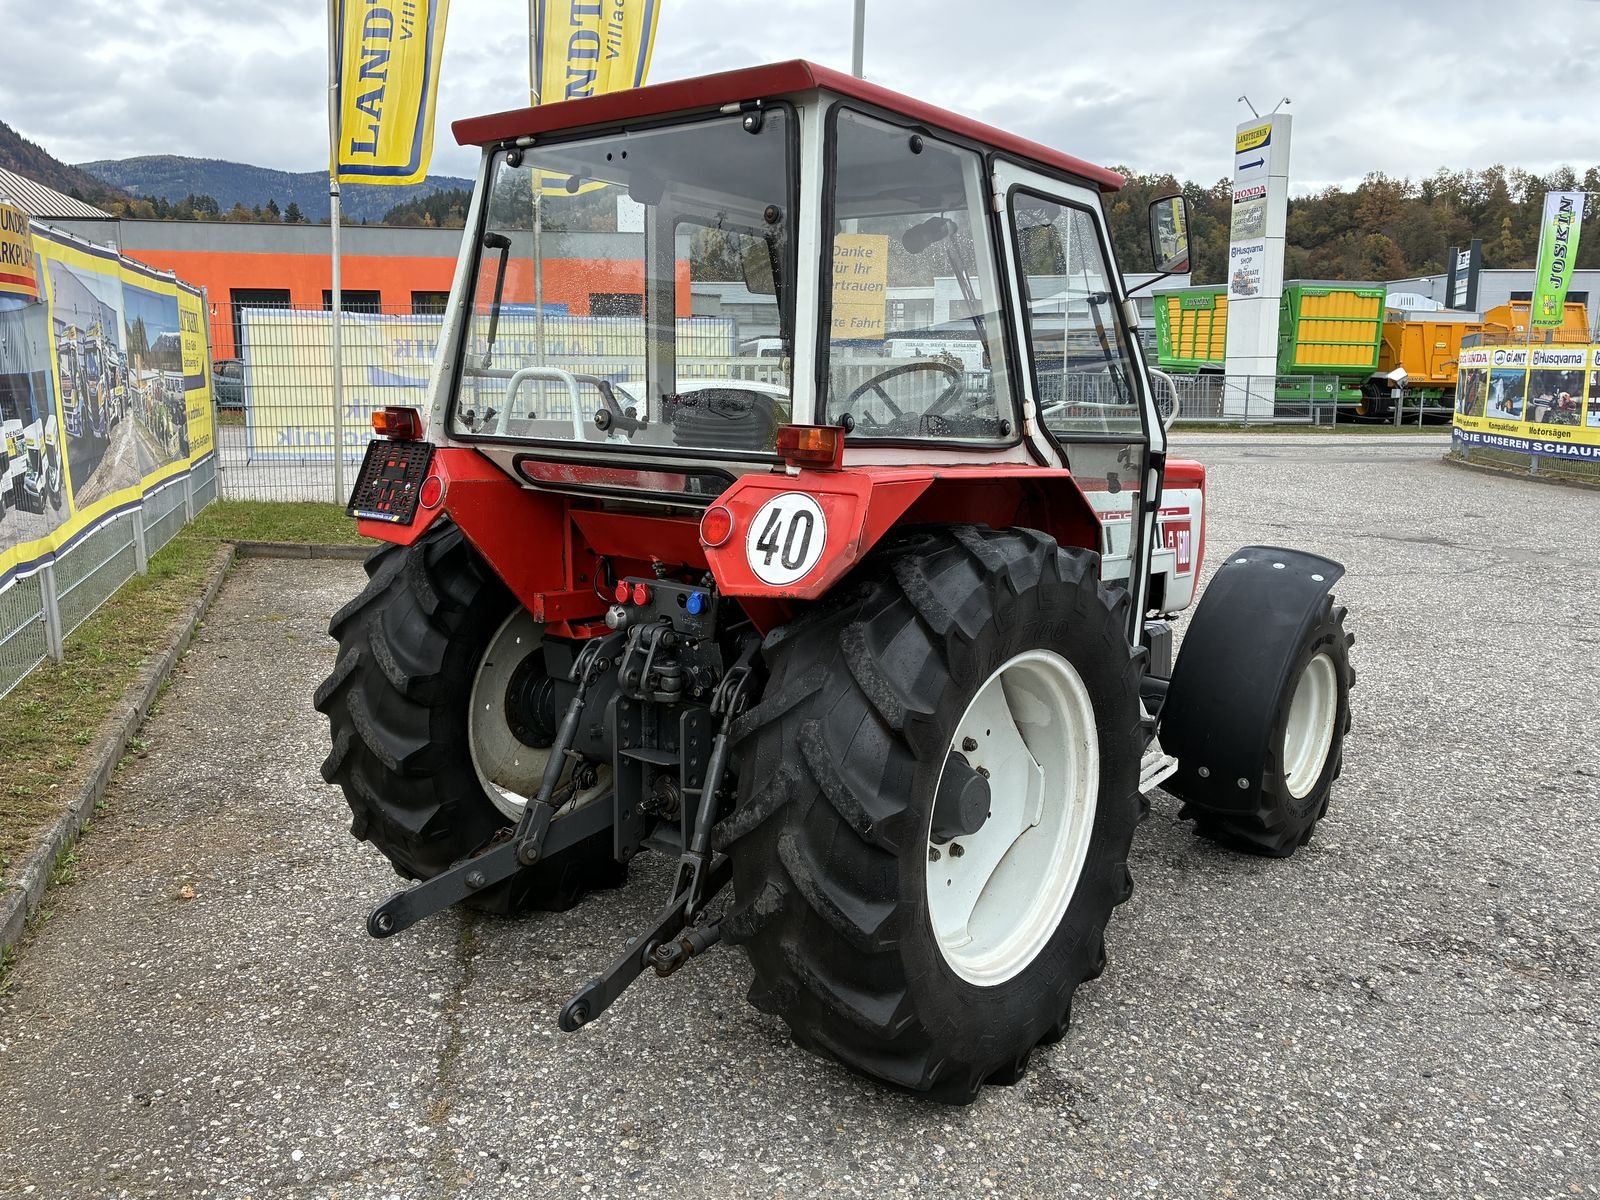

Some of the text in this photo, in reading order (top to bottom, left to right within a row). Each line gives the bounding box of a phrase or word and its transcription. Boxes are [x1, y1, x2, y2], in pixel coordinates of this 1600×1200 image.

[350, 0, 394, 157] LAND
[1234, 185, 1266, 199] HONDA
[1549, 196, 1574, 289] JOSKIN
[832, 245, 873, 257] Danke
[1237, 245, 1263, 255] Husqvarna
[854, 263, 872, 275] Ihr
[834, 280, 883, 292] rtrauen
[833, 318, 882, 329] te Fahrt
[1540, 351, 1582, 365] Husqvarna
[1529, 426, 1572, 438] Motorsägen
[1482, 434, 1529, 450] UNSEREN
[756, 507, 815, 571] 40
[1167, 530, 1175, 547] A
